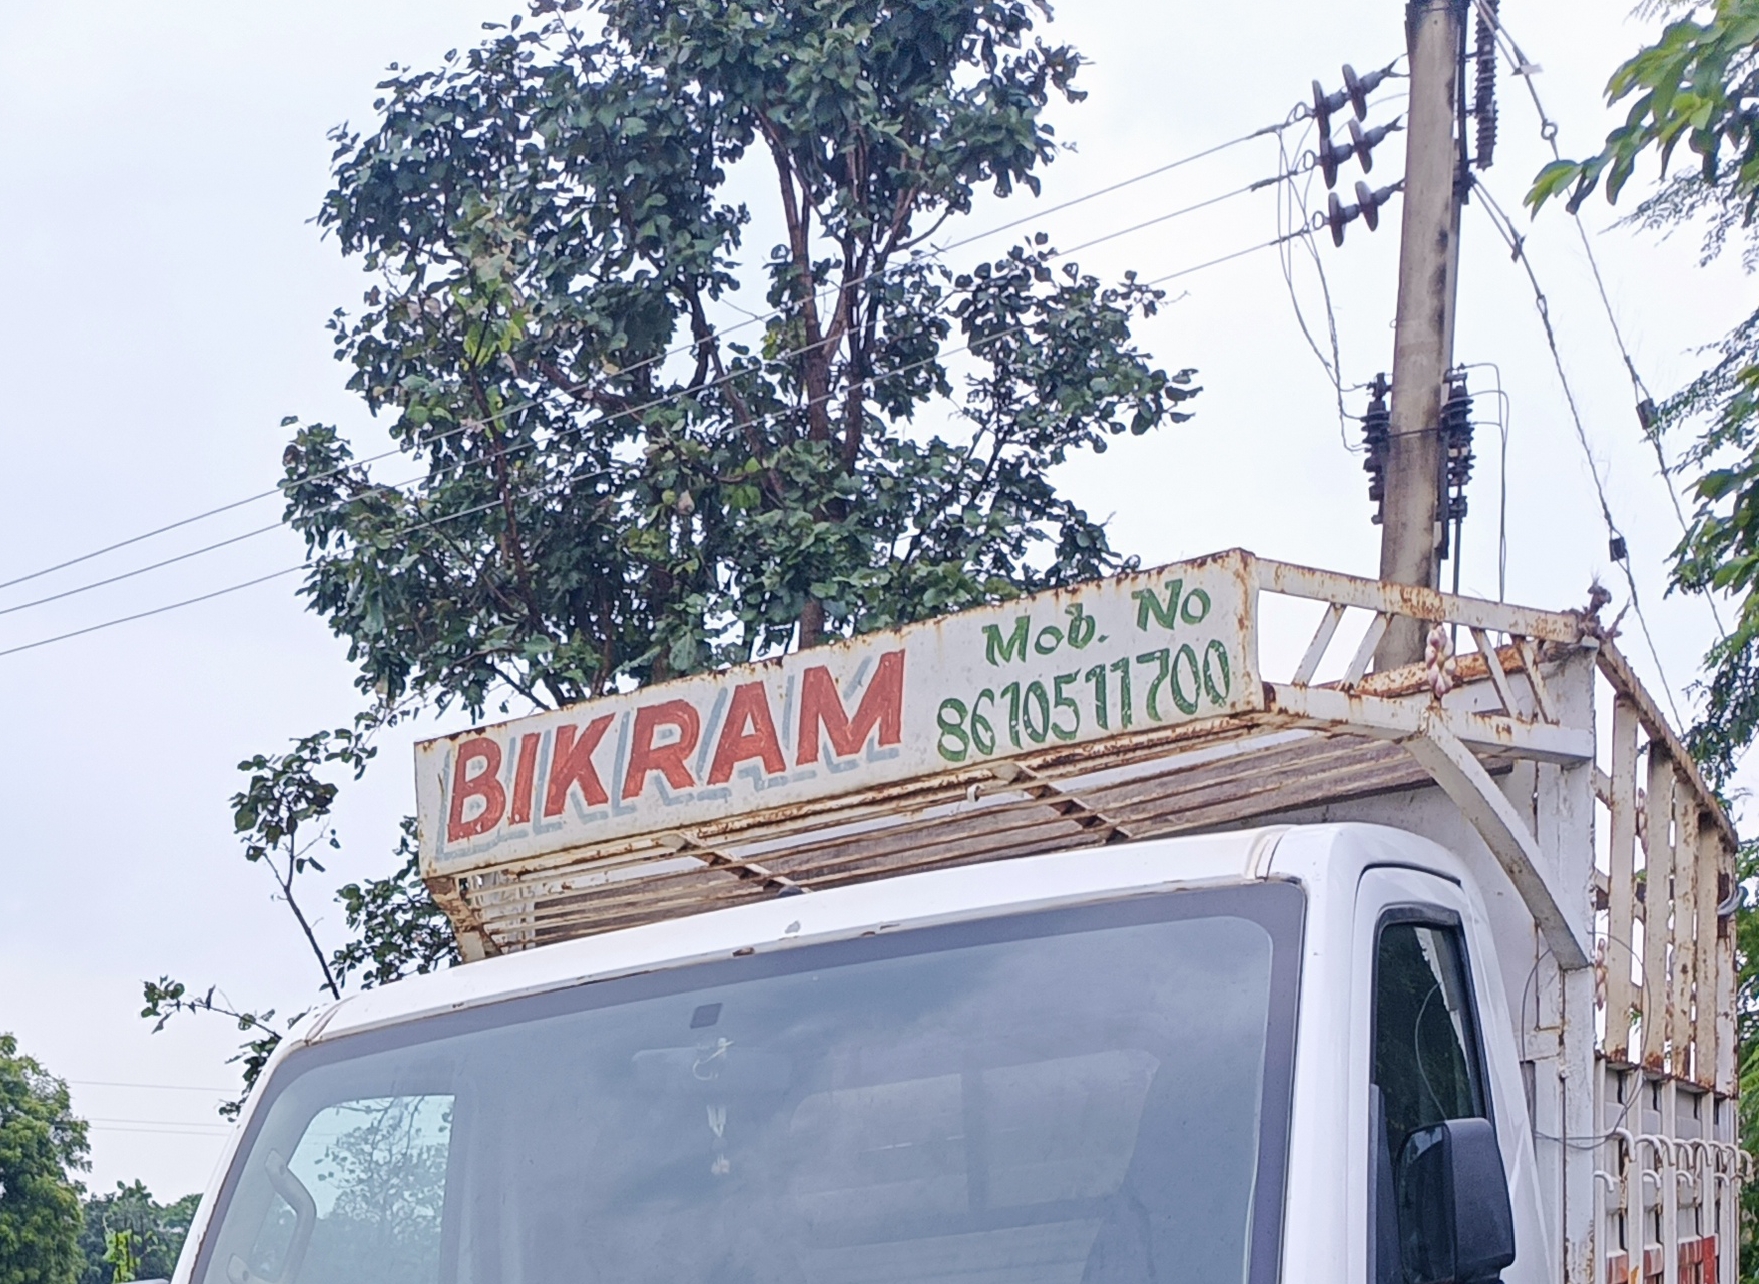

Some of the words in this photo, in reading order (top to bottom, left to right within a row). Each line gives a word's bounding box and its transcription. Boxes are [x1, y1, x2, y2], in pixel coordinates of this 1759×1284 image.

[982, 603, 1109, 668] Mob.
[446, 649, 907, 845] BIKRAM
[936, 638, 1231, 763] 8610511700
